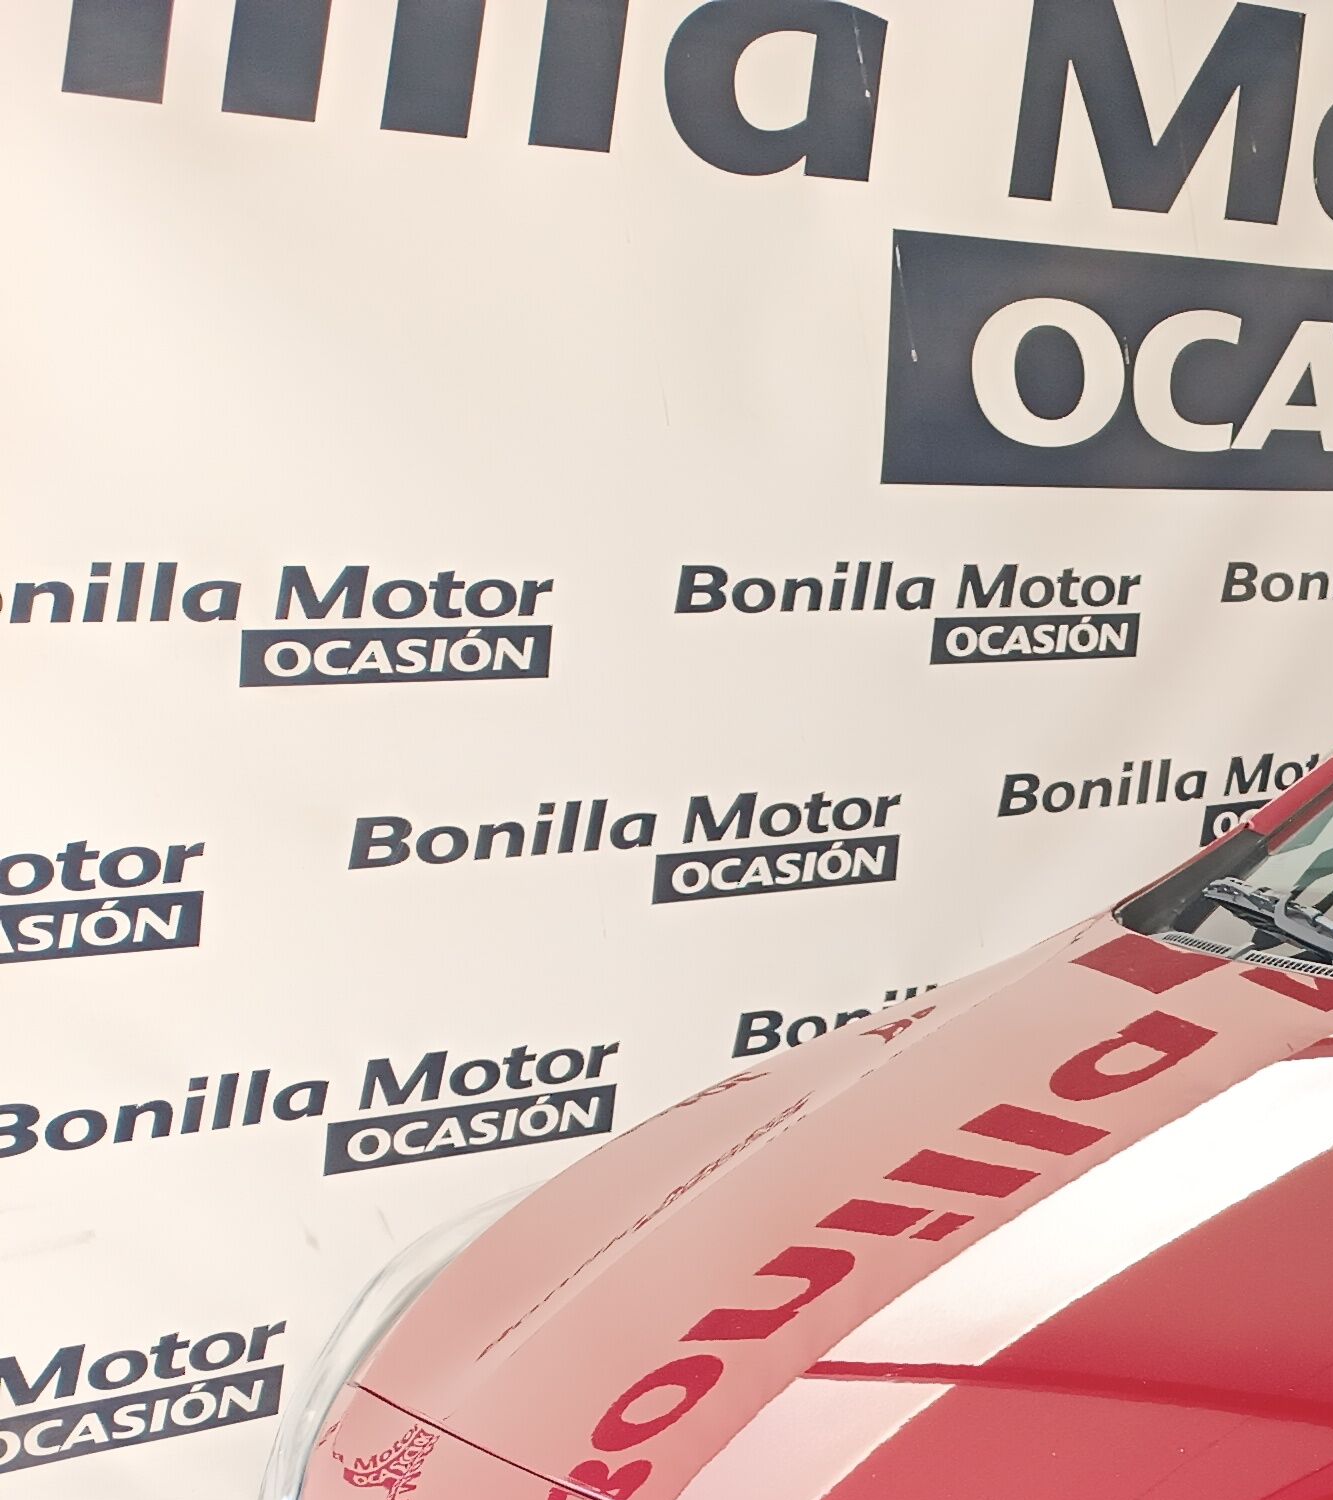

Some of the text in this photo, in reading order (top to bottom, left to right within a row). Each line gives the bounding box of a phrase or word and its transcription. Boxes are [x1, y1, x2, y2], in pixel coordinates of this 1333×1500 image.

[0, 562, 554, 624] nilla Motor
[674, 561, 1142, 614] Bonilla Motor
[264, 630, 535, 677] OCASIÓN
[944, 616, 1129, 657] OCASIÓN
[997, 758, 1208, 817] Bonilla
[348, 791, 902, 870] Bonilla Motor
[670, 843, 889, 895] OCASIÓN
[359, 1041, 620, 1110] Motor
[346, 1095, 603, 1163] OCASIÓN
